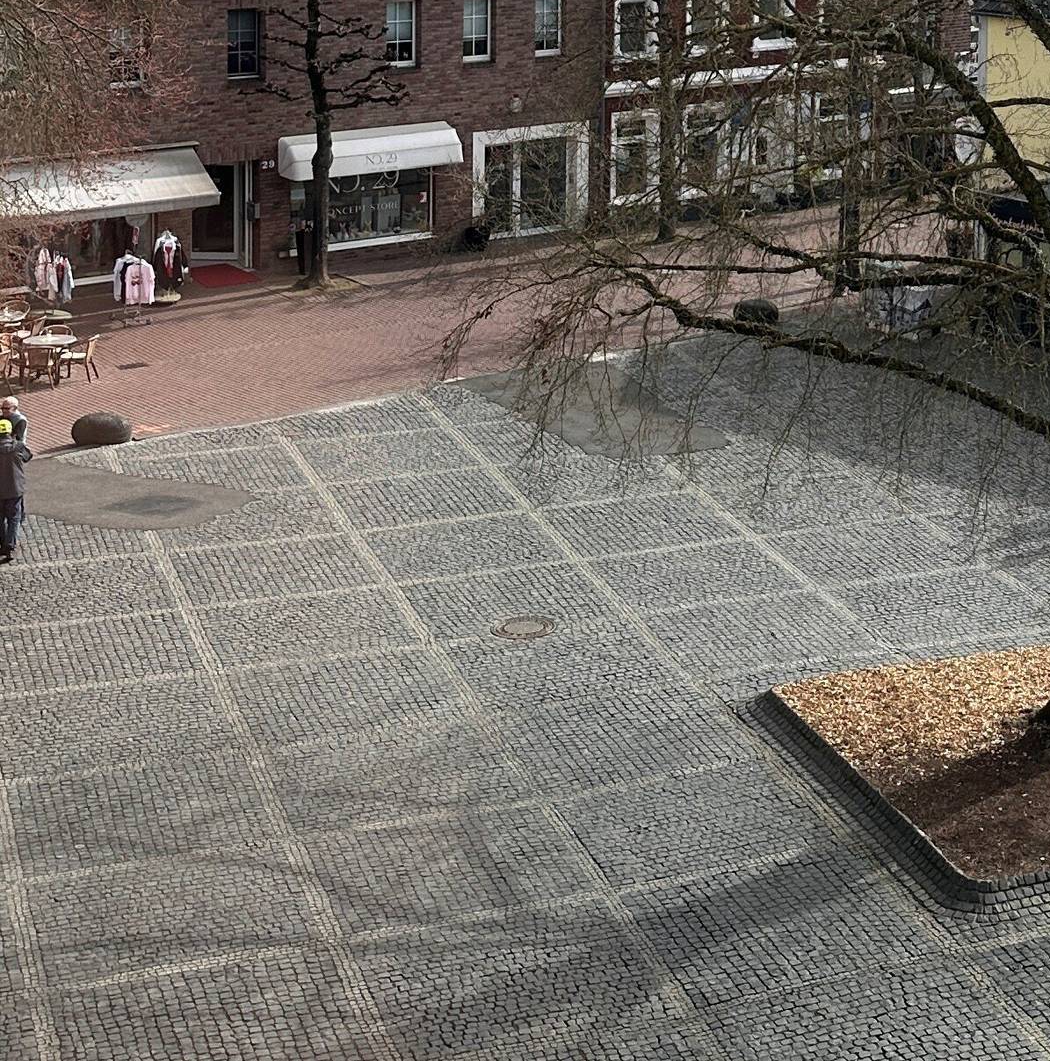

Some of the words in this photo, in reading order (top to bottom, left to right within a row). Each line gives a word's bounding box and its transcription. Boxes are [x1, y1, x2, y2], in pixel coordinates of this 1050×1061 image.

[261, 160, 275, 170] 29
[384, 152, 398, 164] 29
[371, 170, 400, 189] 29
[328, 204, 366, 217] ONCEPT
[368, 200, 399, 211] STORE
